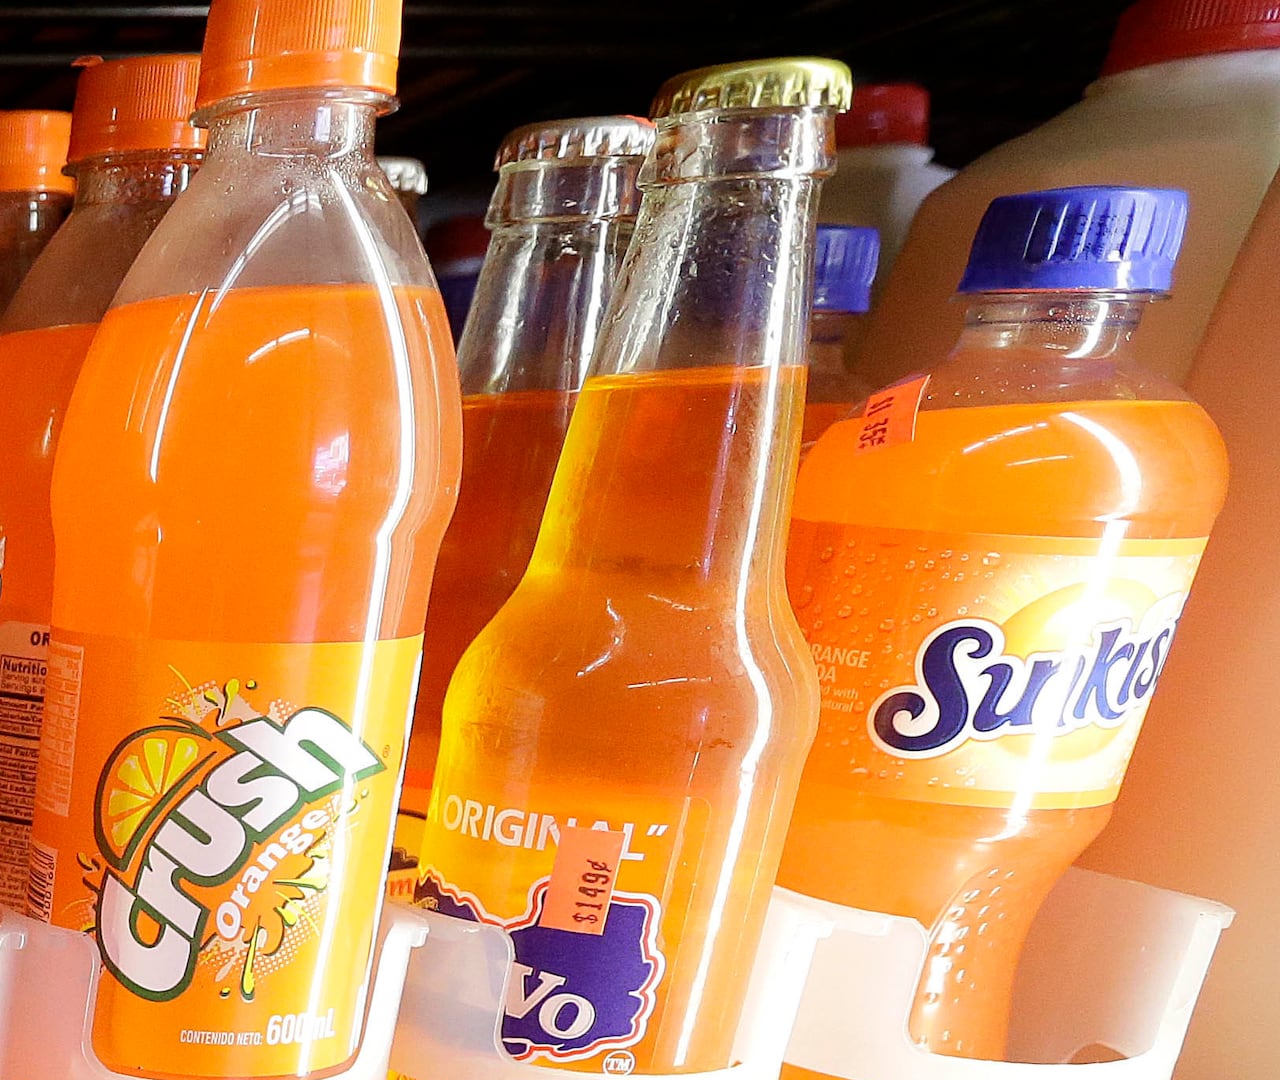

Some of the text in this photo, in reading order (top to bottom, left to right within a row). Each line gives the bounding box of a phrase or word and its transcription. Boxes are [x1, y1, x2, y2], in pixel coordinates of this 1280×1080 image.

[98, 705, 384, 993] Crush
[215, 807, 330, 940] Orange
[179, 1029, 235, 1046] CONTENIDO
[236, 1032, 263, 1046] NETO:
